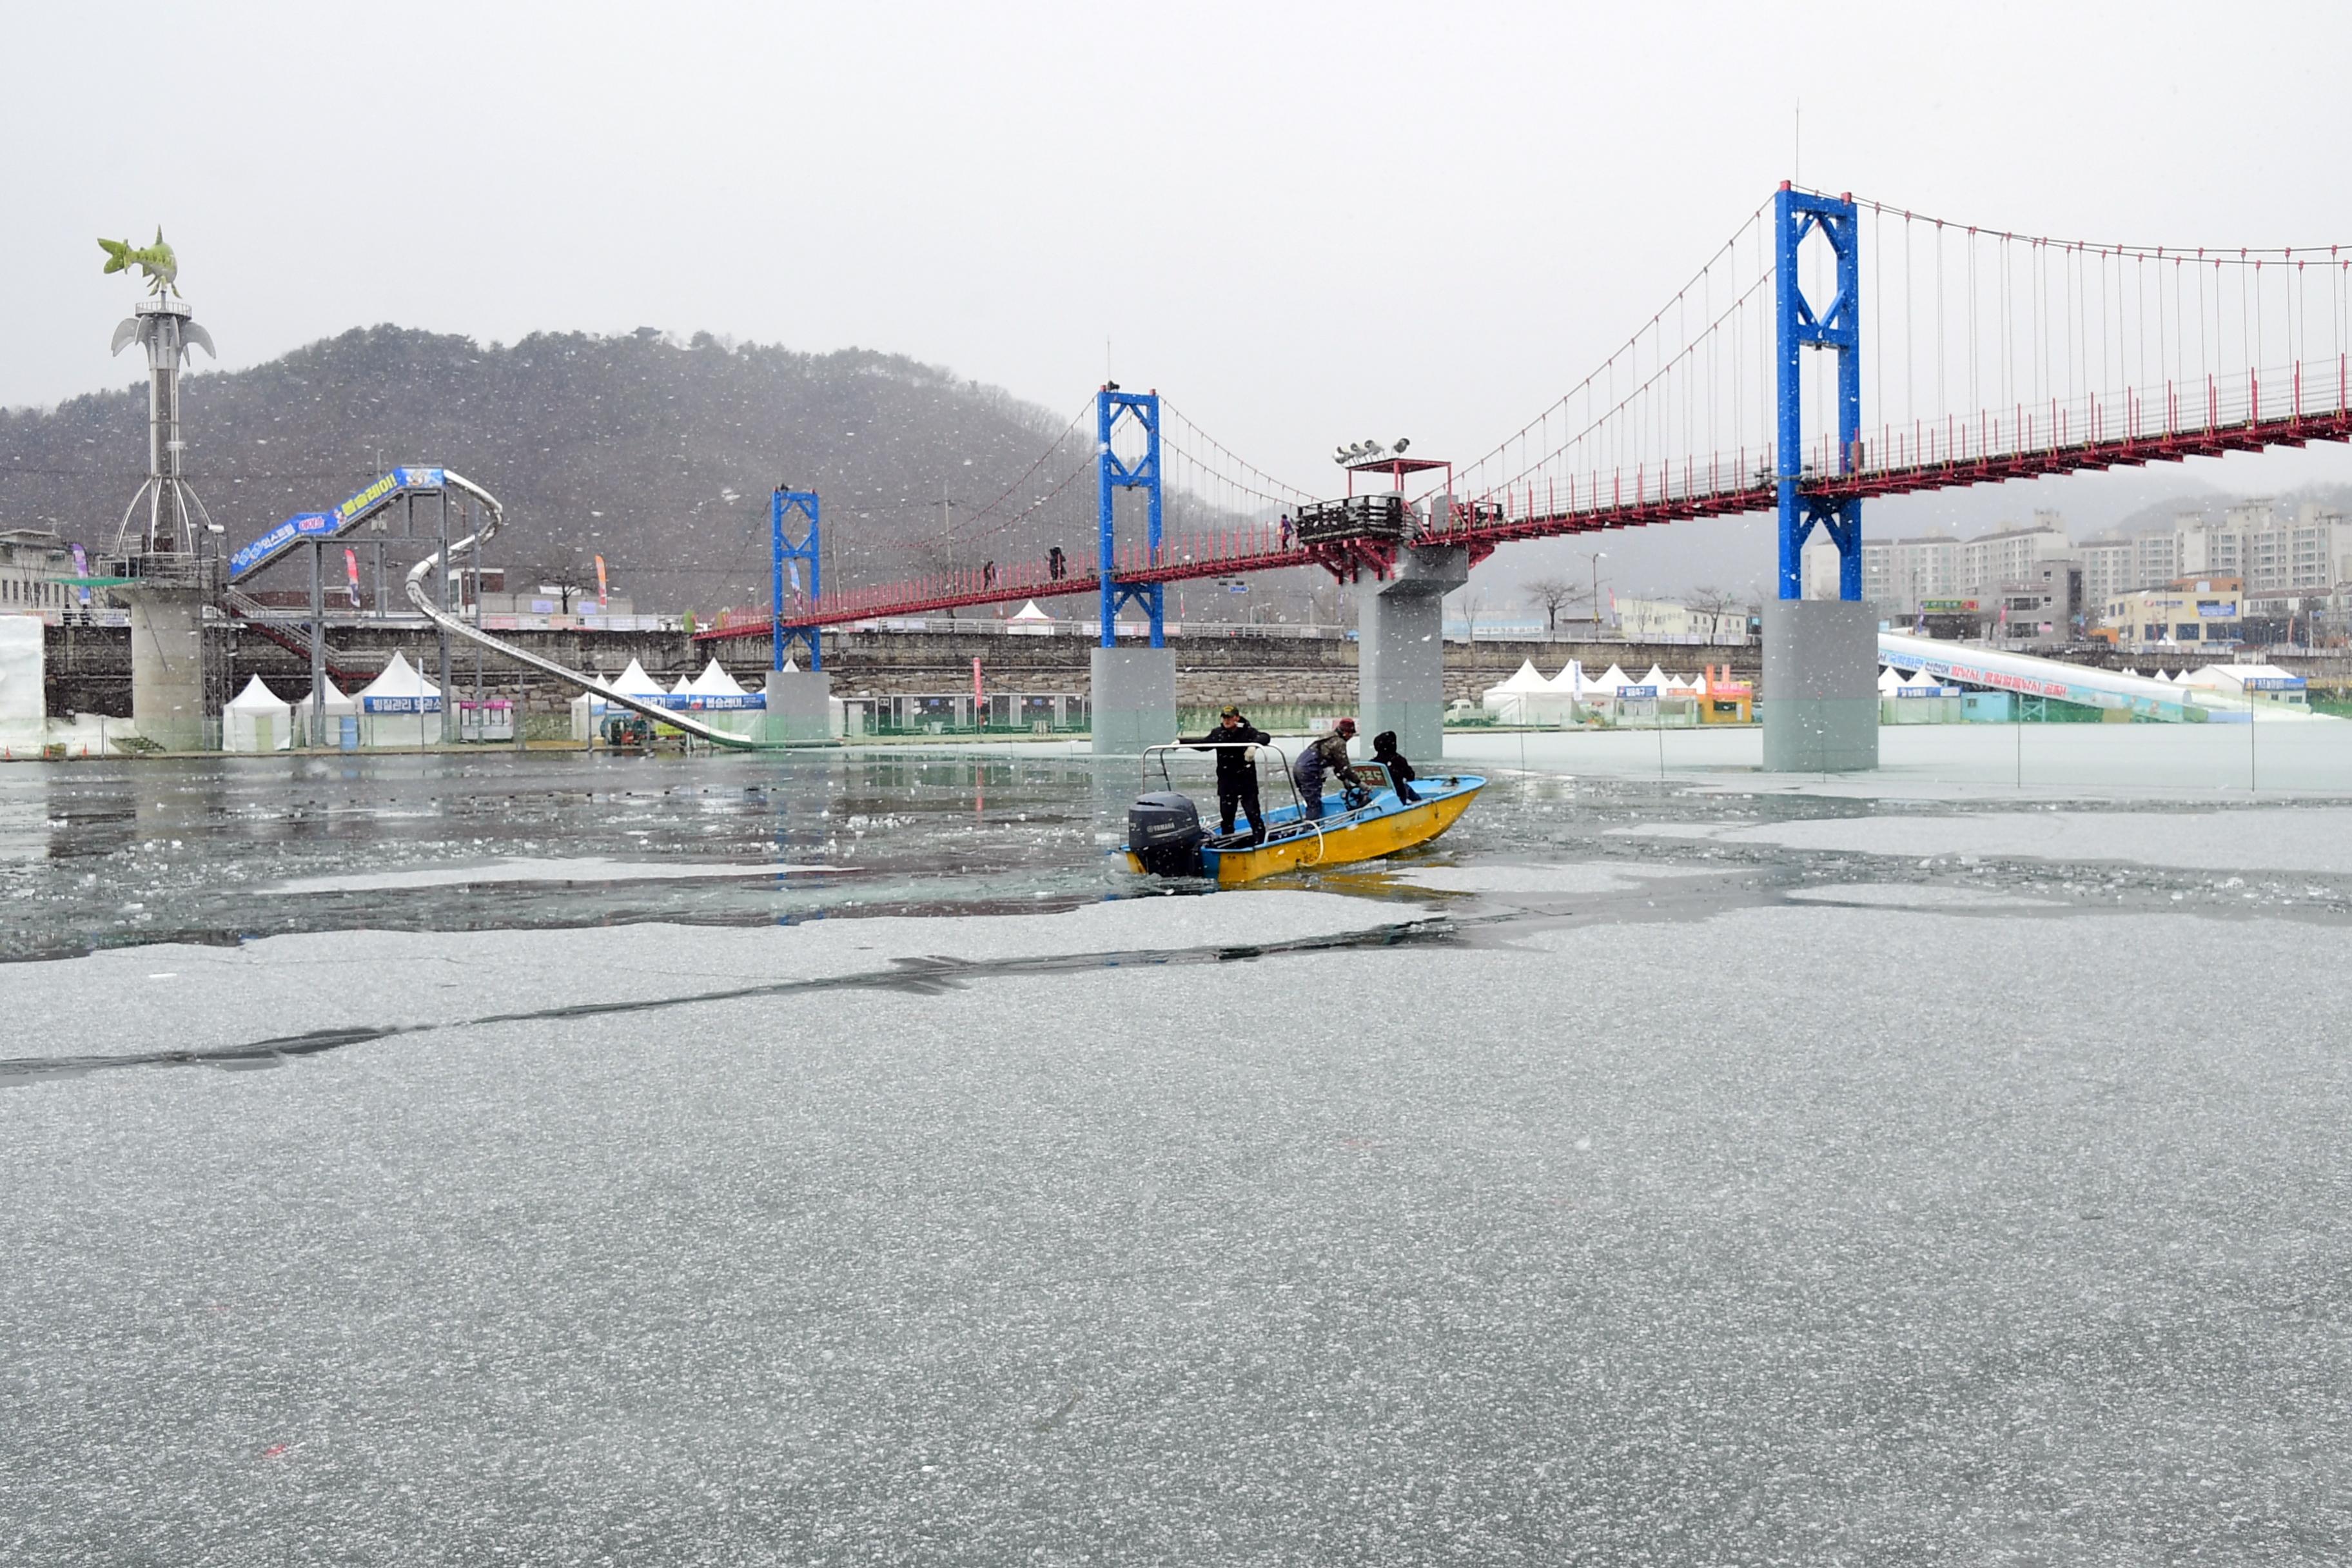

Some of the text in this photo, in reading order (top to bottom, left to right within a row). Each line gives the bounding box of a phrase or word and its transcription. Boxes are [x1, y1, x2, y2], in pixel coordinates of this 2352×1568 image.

[299, 516, 325, 531] 아이스
[341, 473, 398, 516] 봅슬레이!
[1925, 661, 1949, 674] 산천어
[372, 698, 412, 711] 빙질관리
[706, 694, 742, 709] 봅슬레이
[1153, 822, 1175, 831] YAMAHA
